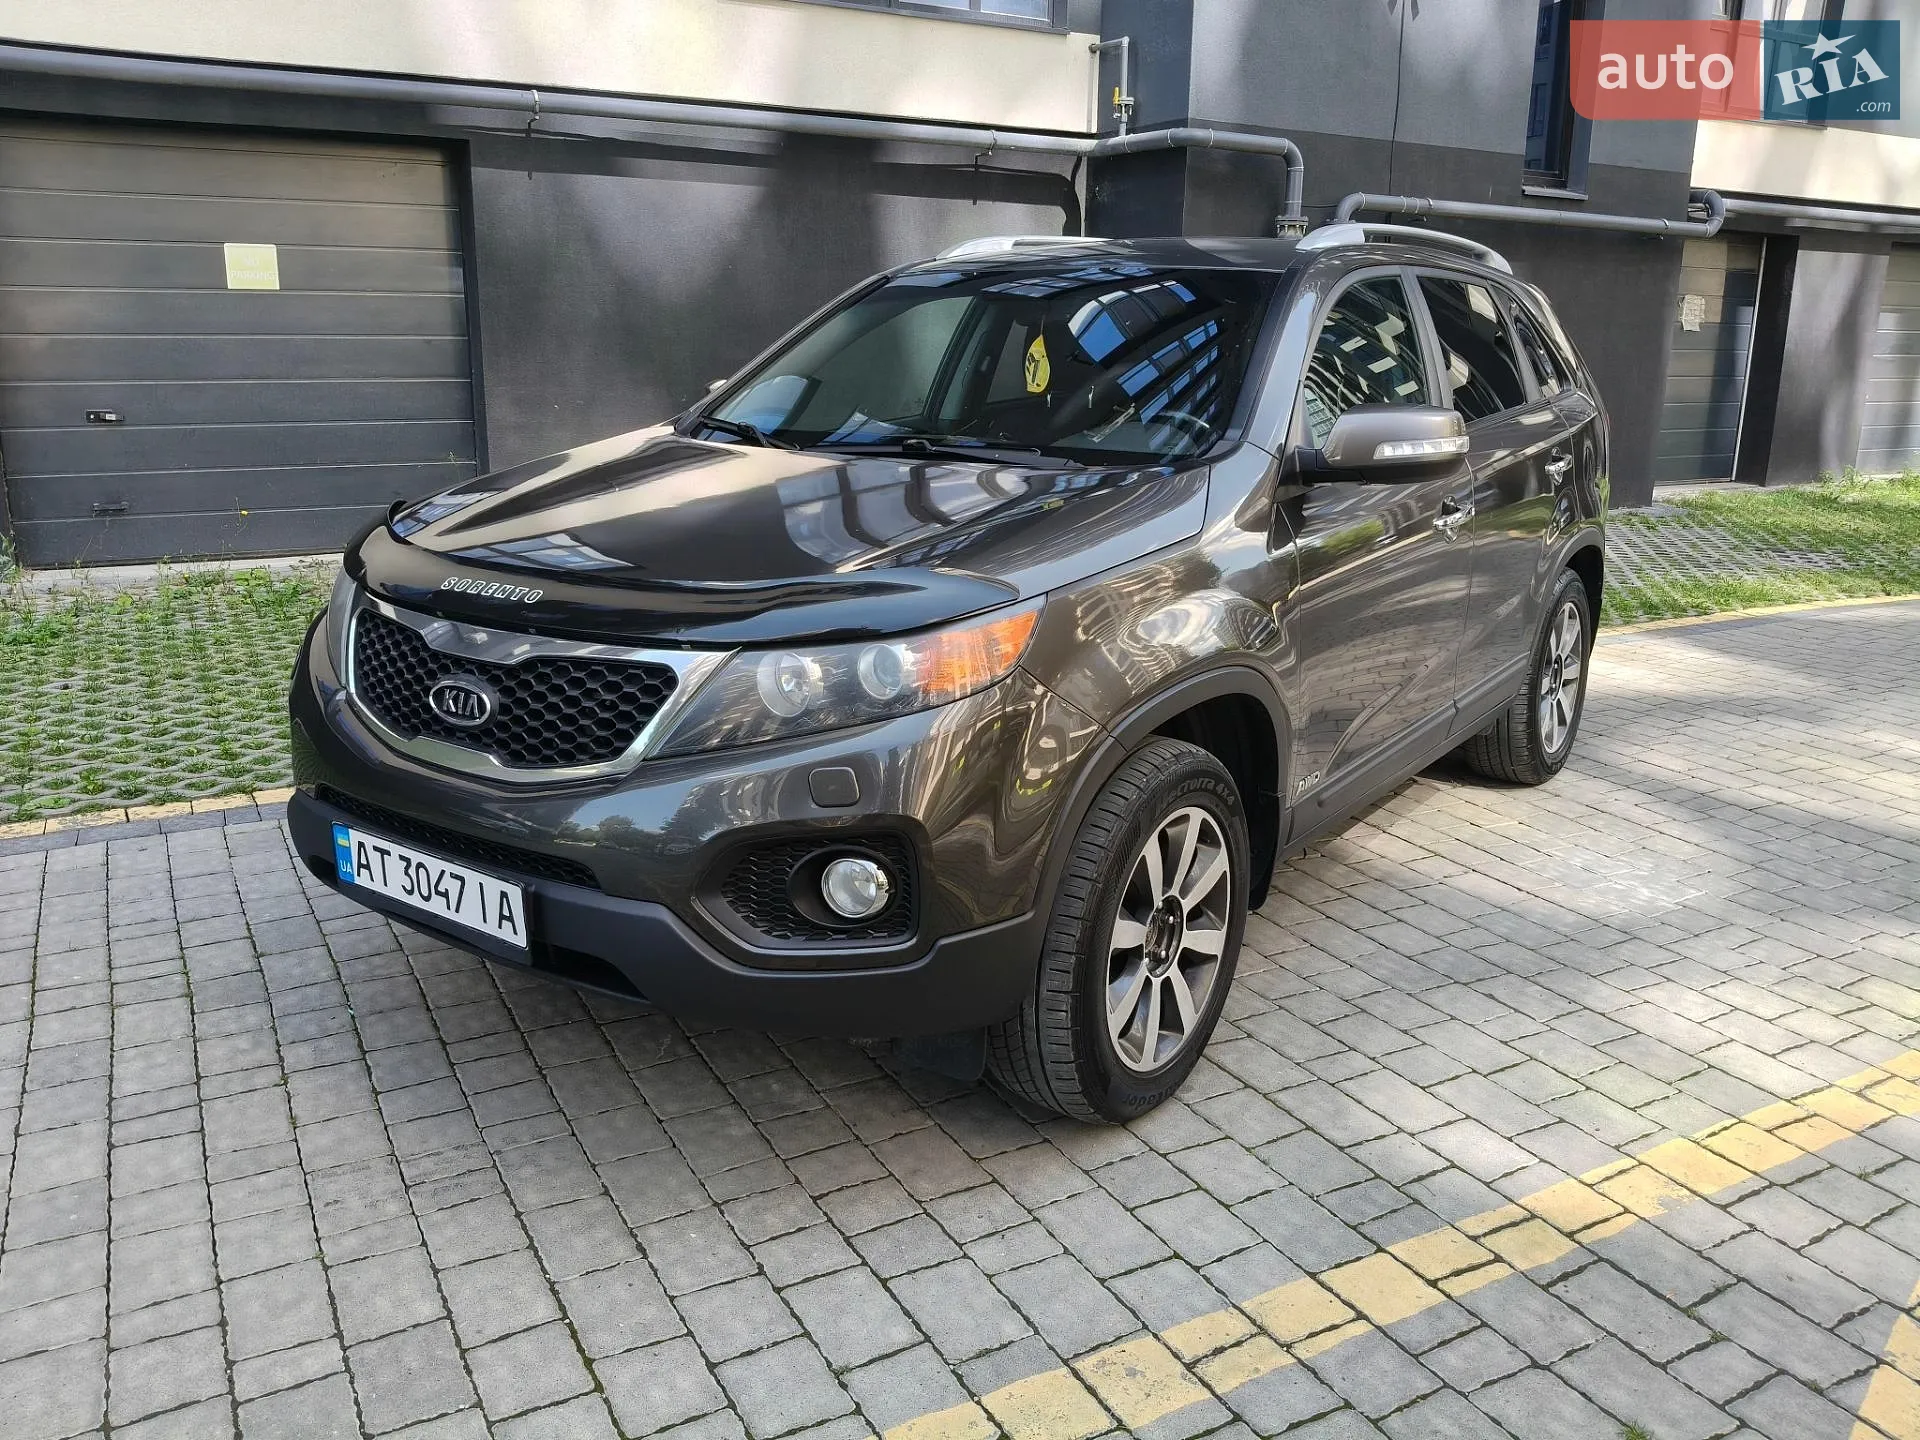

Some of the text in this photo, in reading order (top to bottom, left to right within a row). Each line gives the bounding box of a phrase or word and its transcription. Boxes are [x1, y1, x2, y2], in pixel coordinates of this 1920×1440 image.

[441, 577, 544, 604] SORENTO
[442, 688, 480, 718] KIA
[339, 859, 354, 875] UA
[356, 840, 519, 937] AT 3047 IA
